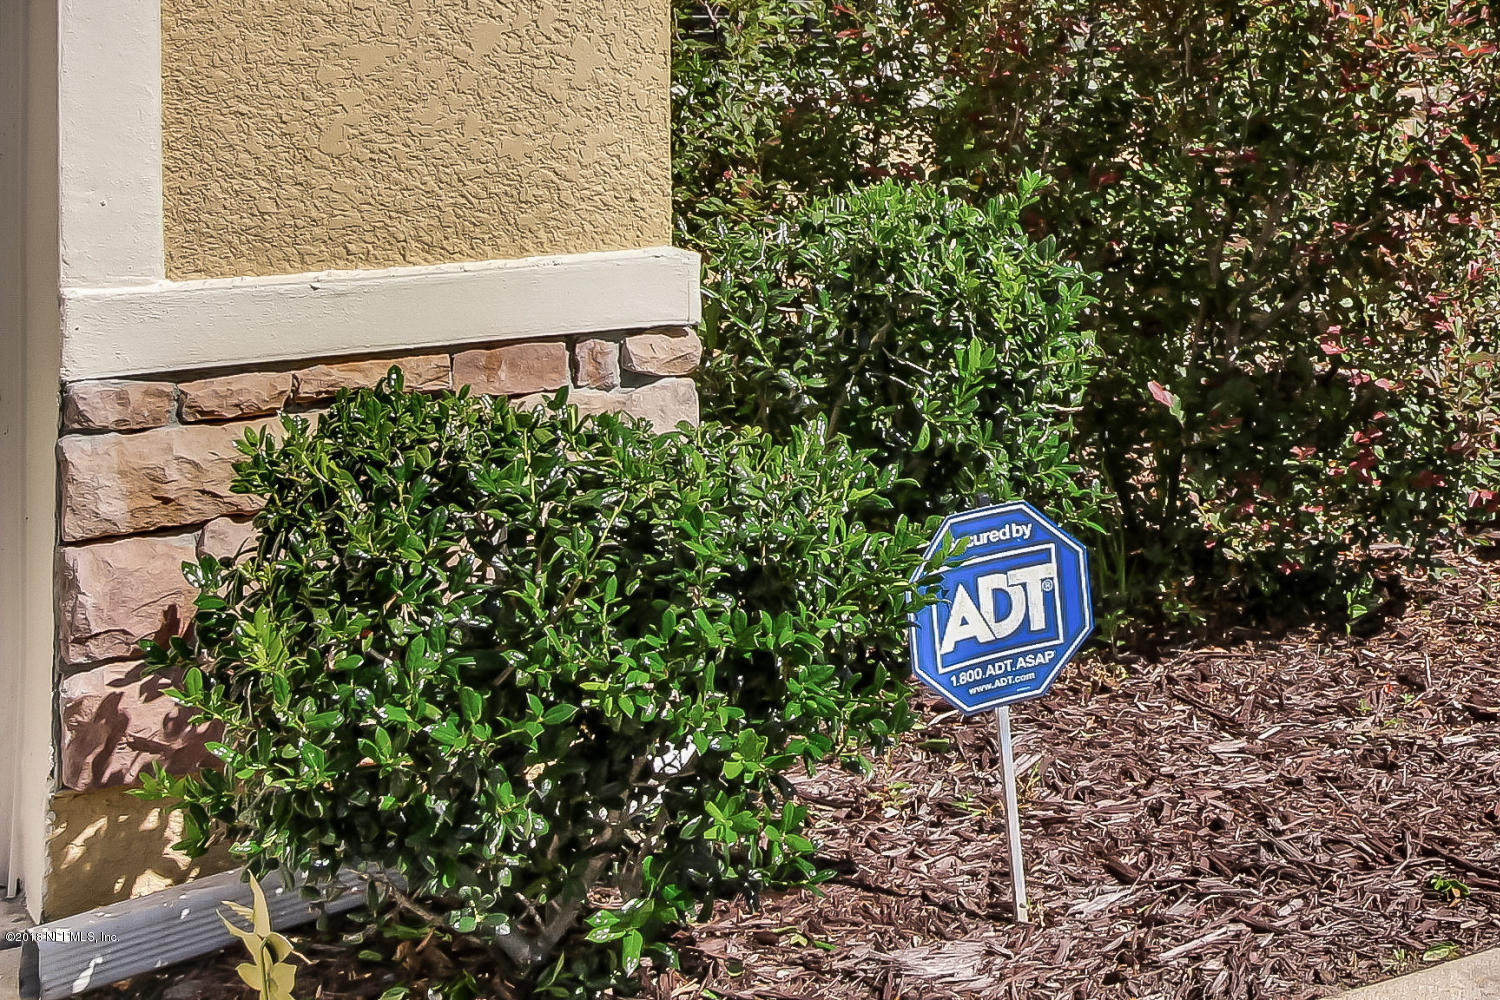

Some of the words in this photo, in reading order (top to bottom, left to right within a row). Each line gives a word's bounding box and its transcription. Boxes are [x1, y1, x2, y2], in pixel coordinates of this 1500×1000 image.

[950, 523, 1010, 550] cured
[1011, 522, 1032, 540] by
[950, 650, 1056, 687] 1.800.ADT.ASAP
[968, 672, 1036, 695] www.ADT.com
